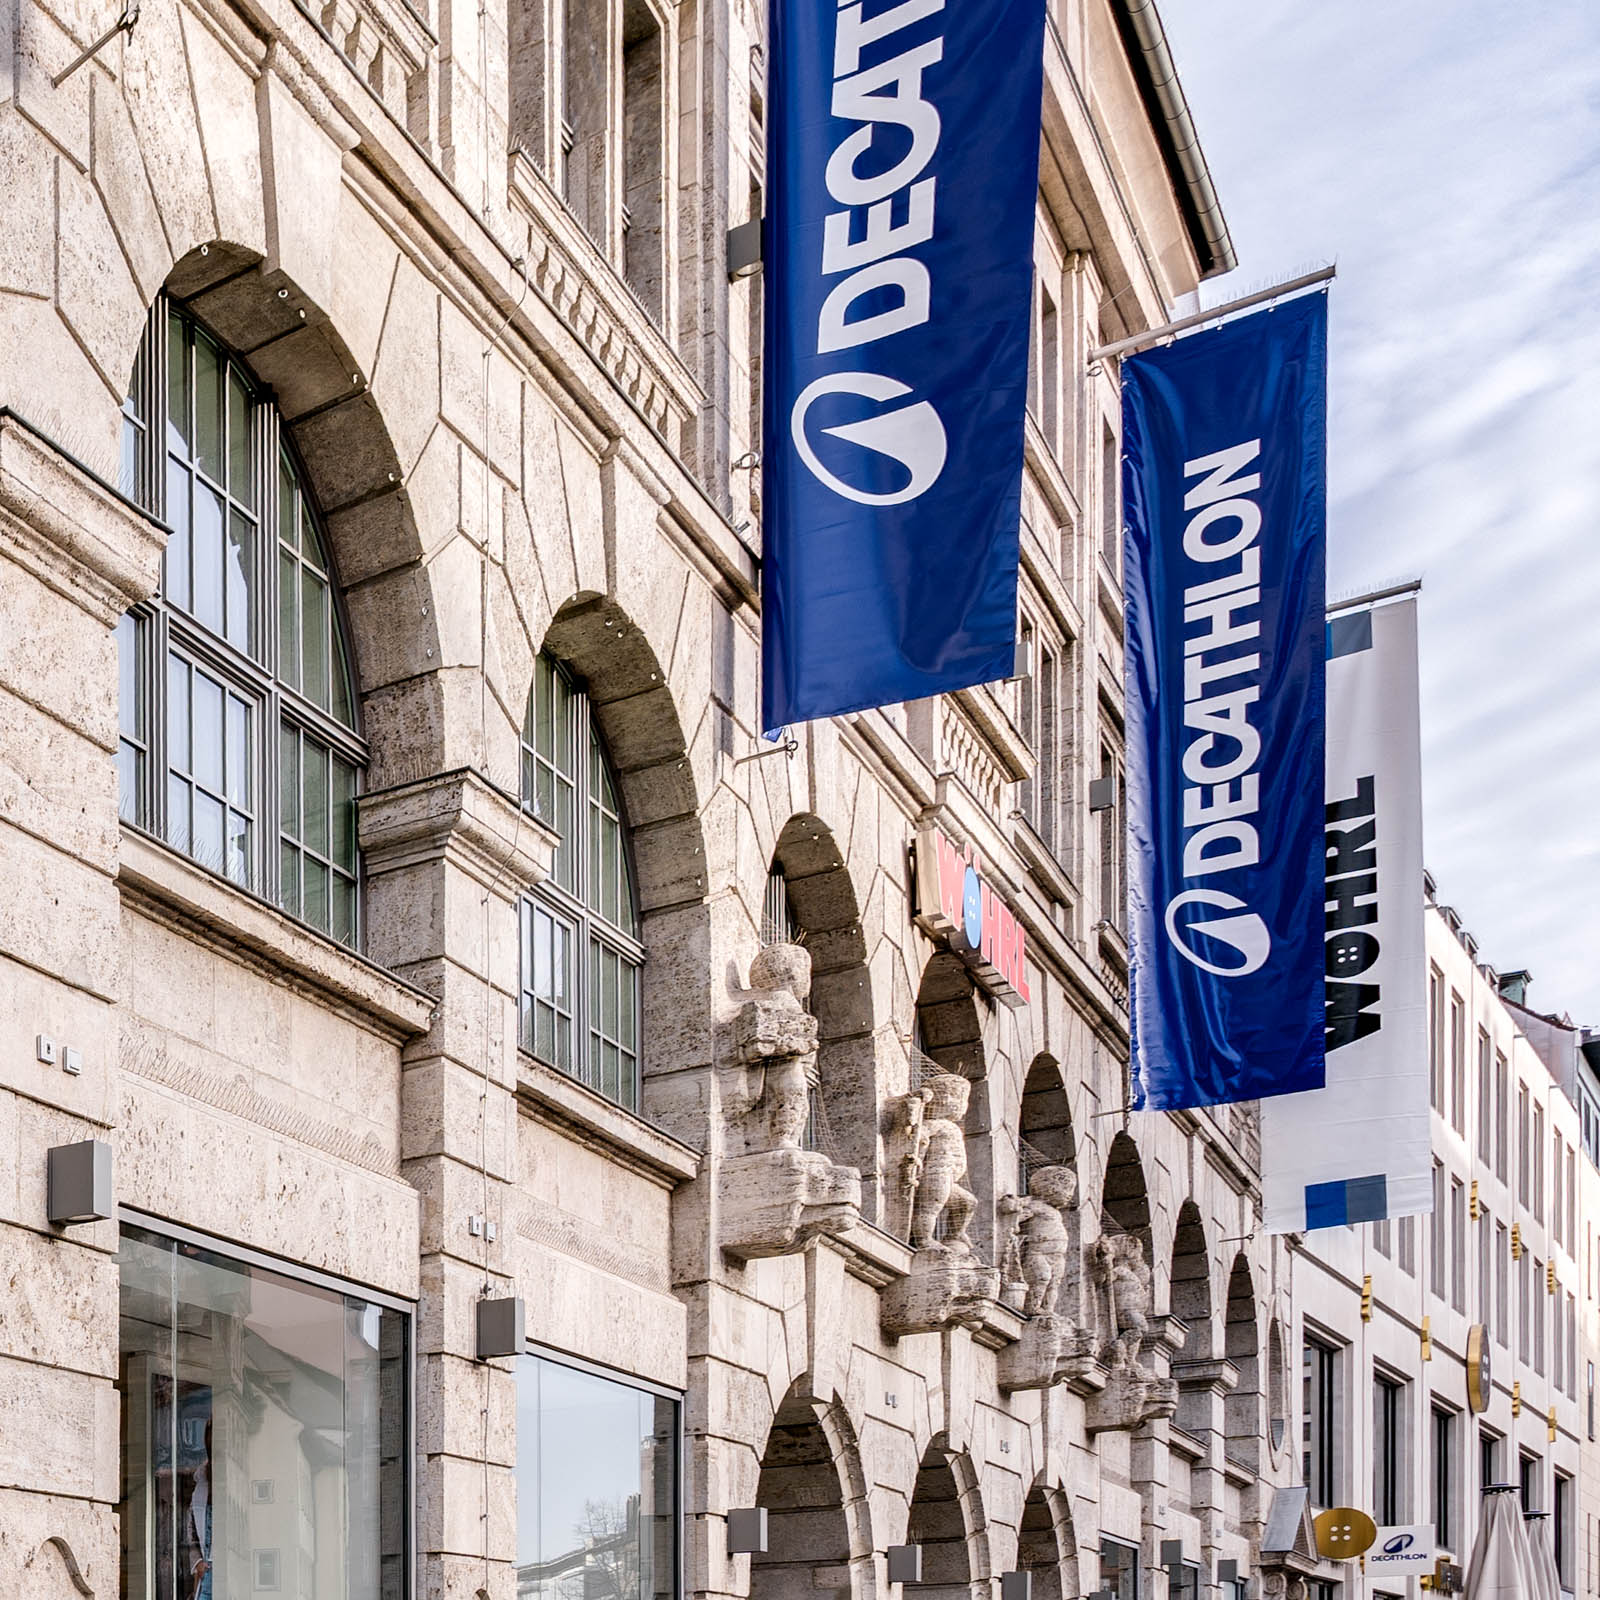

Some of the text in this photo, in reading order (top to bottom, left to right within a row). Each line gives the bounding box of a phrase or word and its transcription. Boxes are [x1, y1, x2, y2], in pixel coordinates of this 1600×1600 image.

[818, 0, 946, 355] DECAT
[1183, 438, 1262, 878] DECATHLON
[935, 828, 1031, 1003] WÖHRL
[1371, 1553, 1428, 1562] DECATHLON
